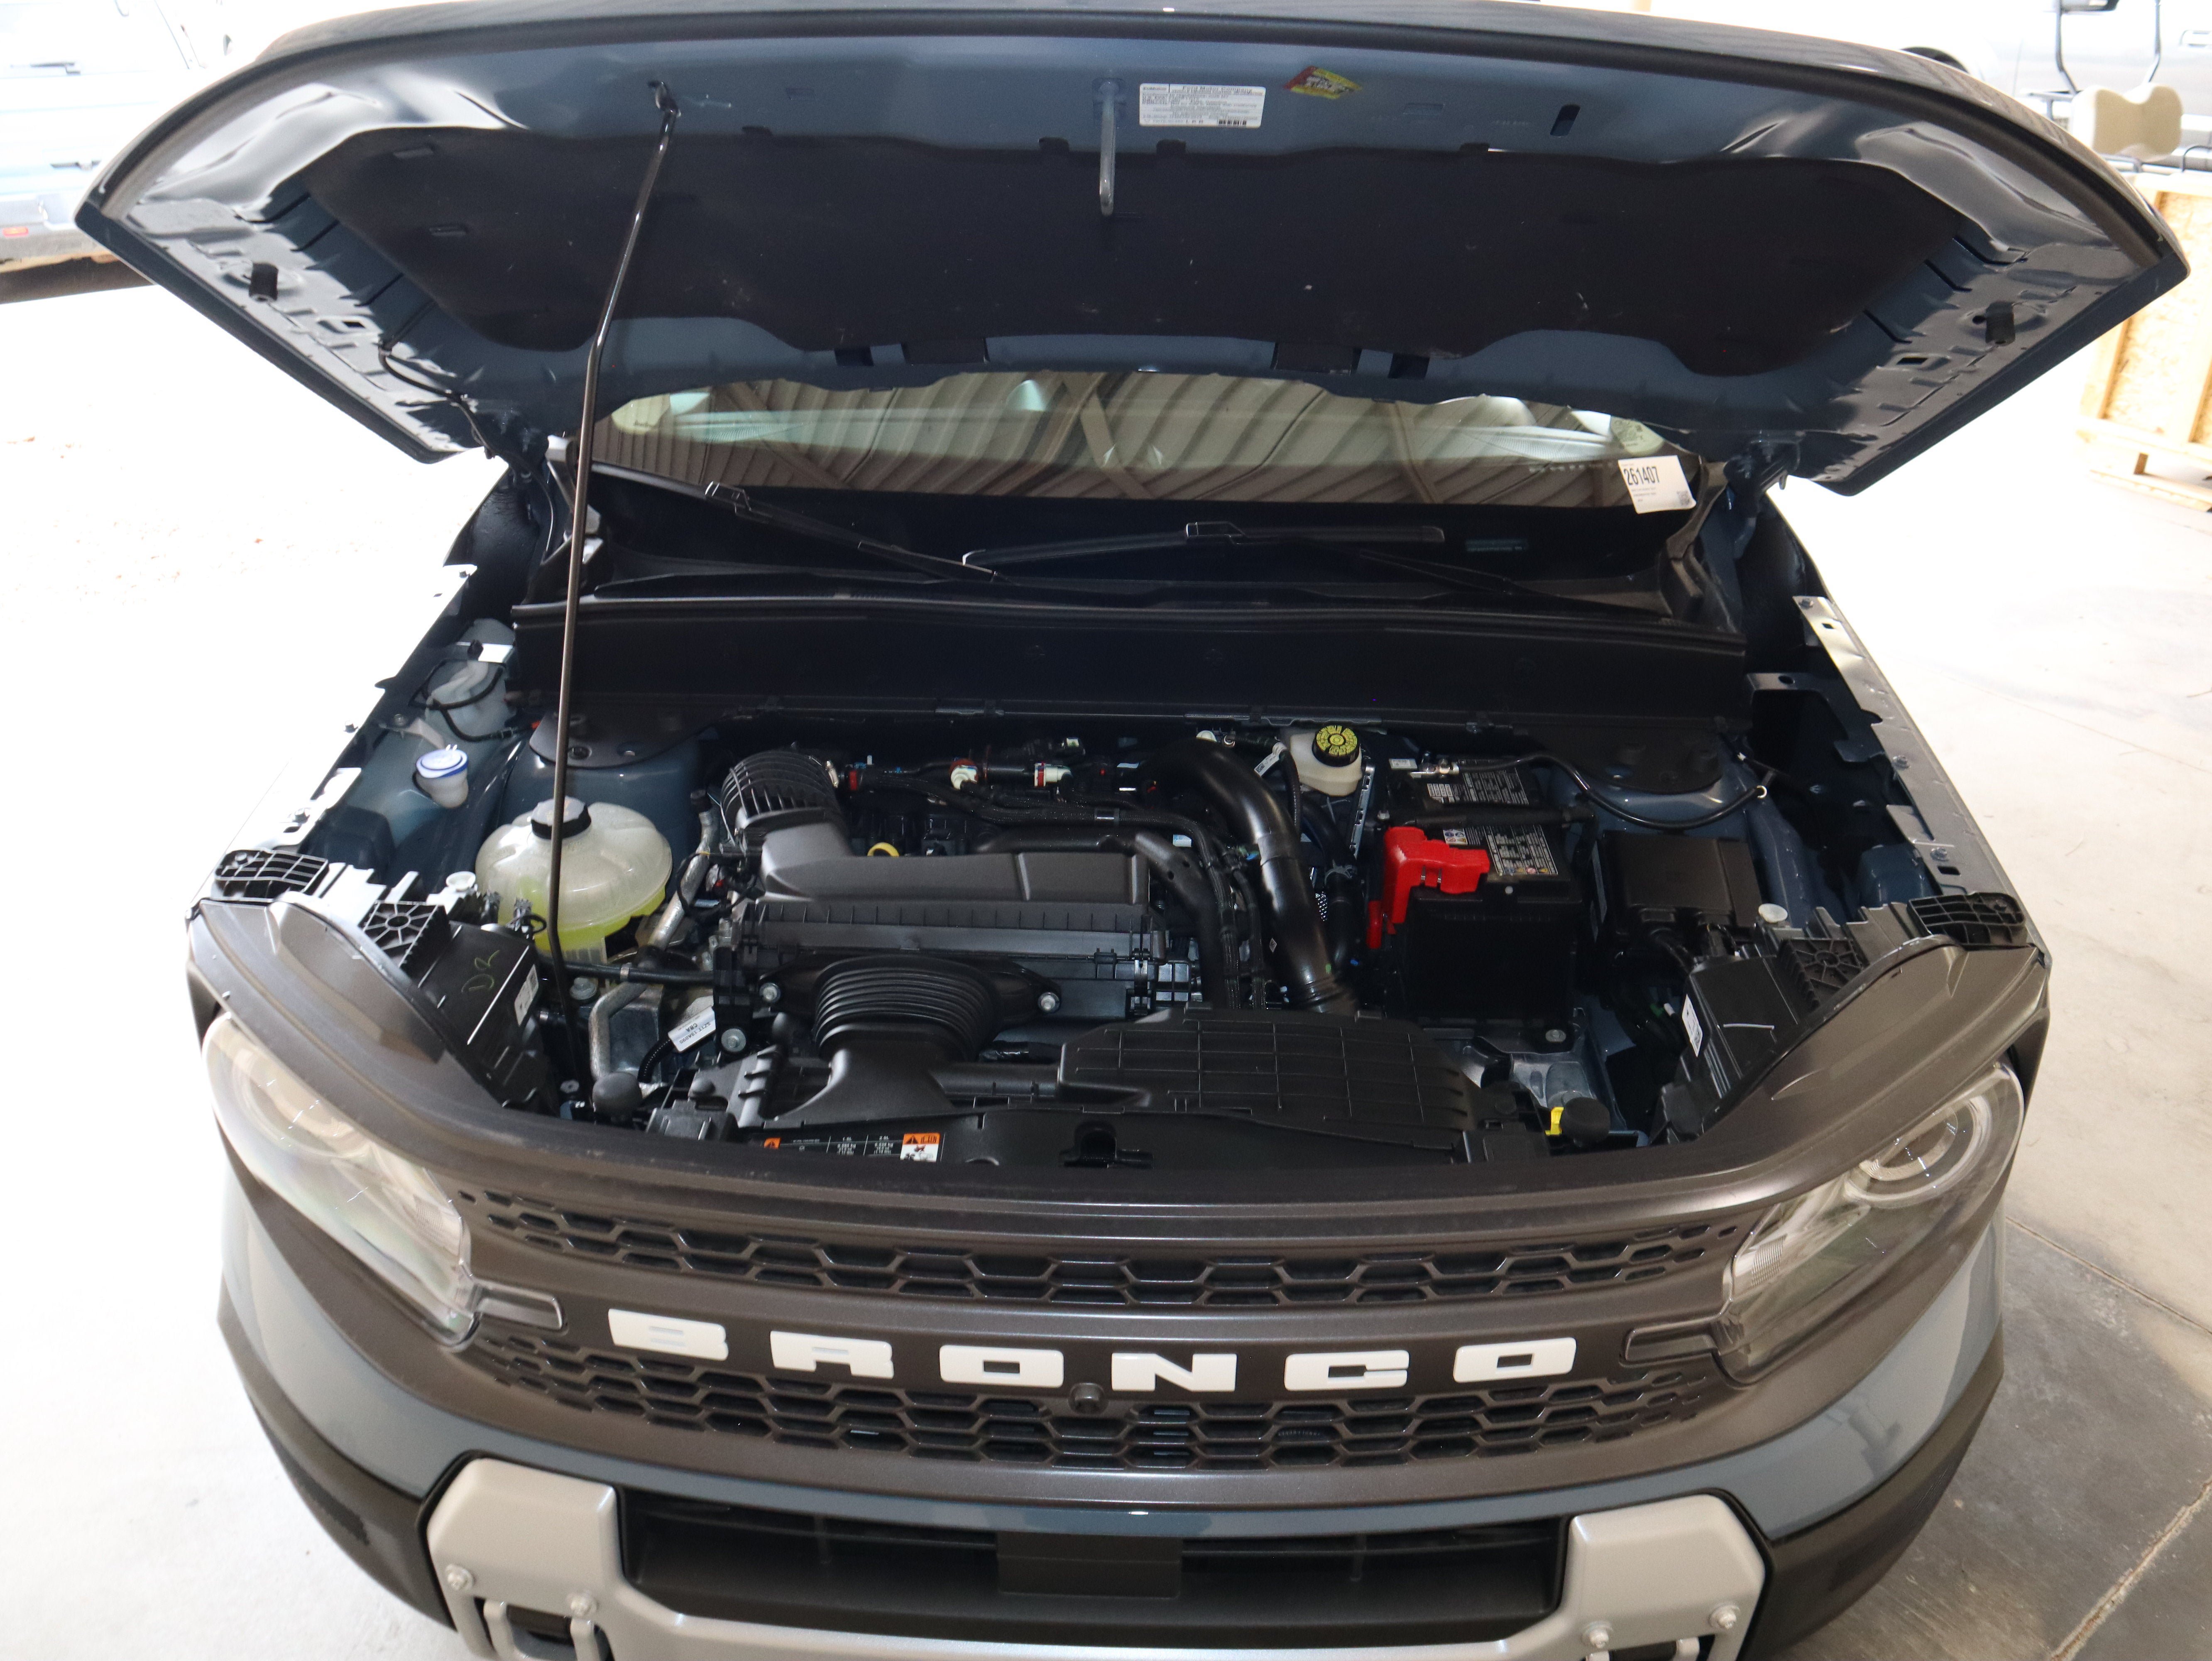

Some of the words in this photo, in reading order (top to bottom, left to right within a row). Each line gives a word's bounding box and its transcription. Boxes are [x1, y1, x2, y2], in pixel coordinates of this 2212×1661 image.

[1623, 466, 1660, 485] 261407
[685, 1022, 698, 1032] CBA
[608, 1309, 1576, 1390] BRONCO
